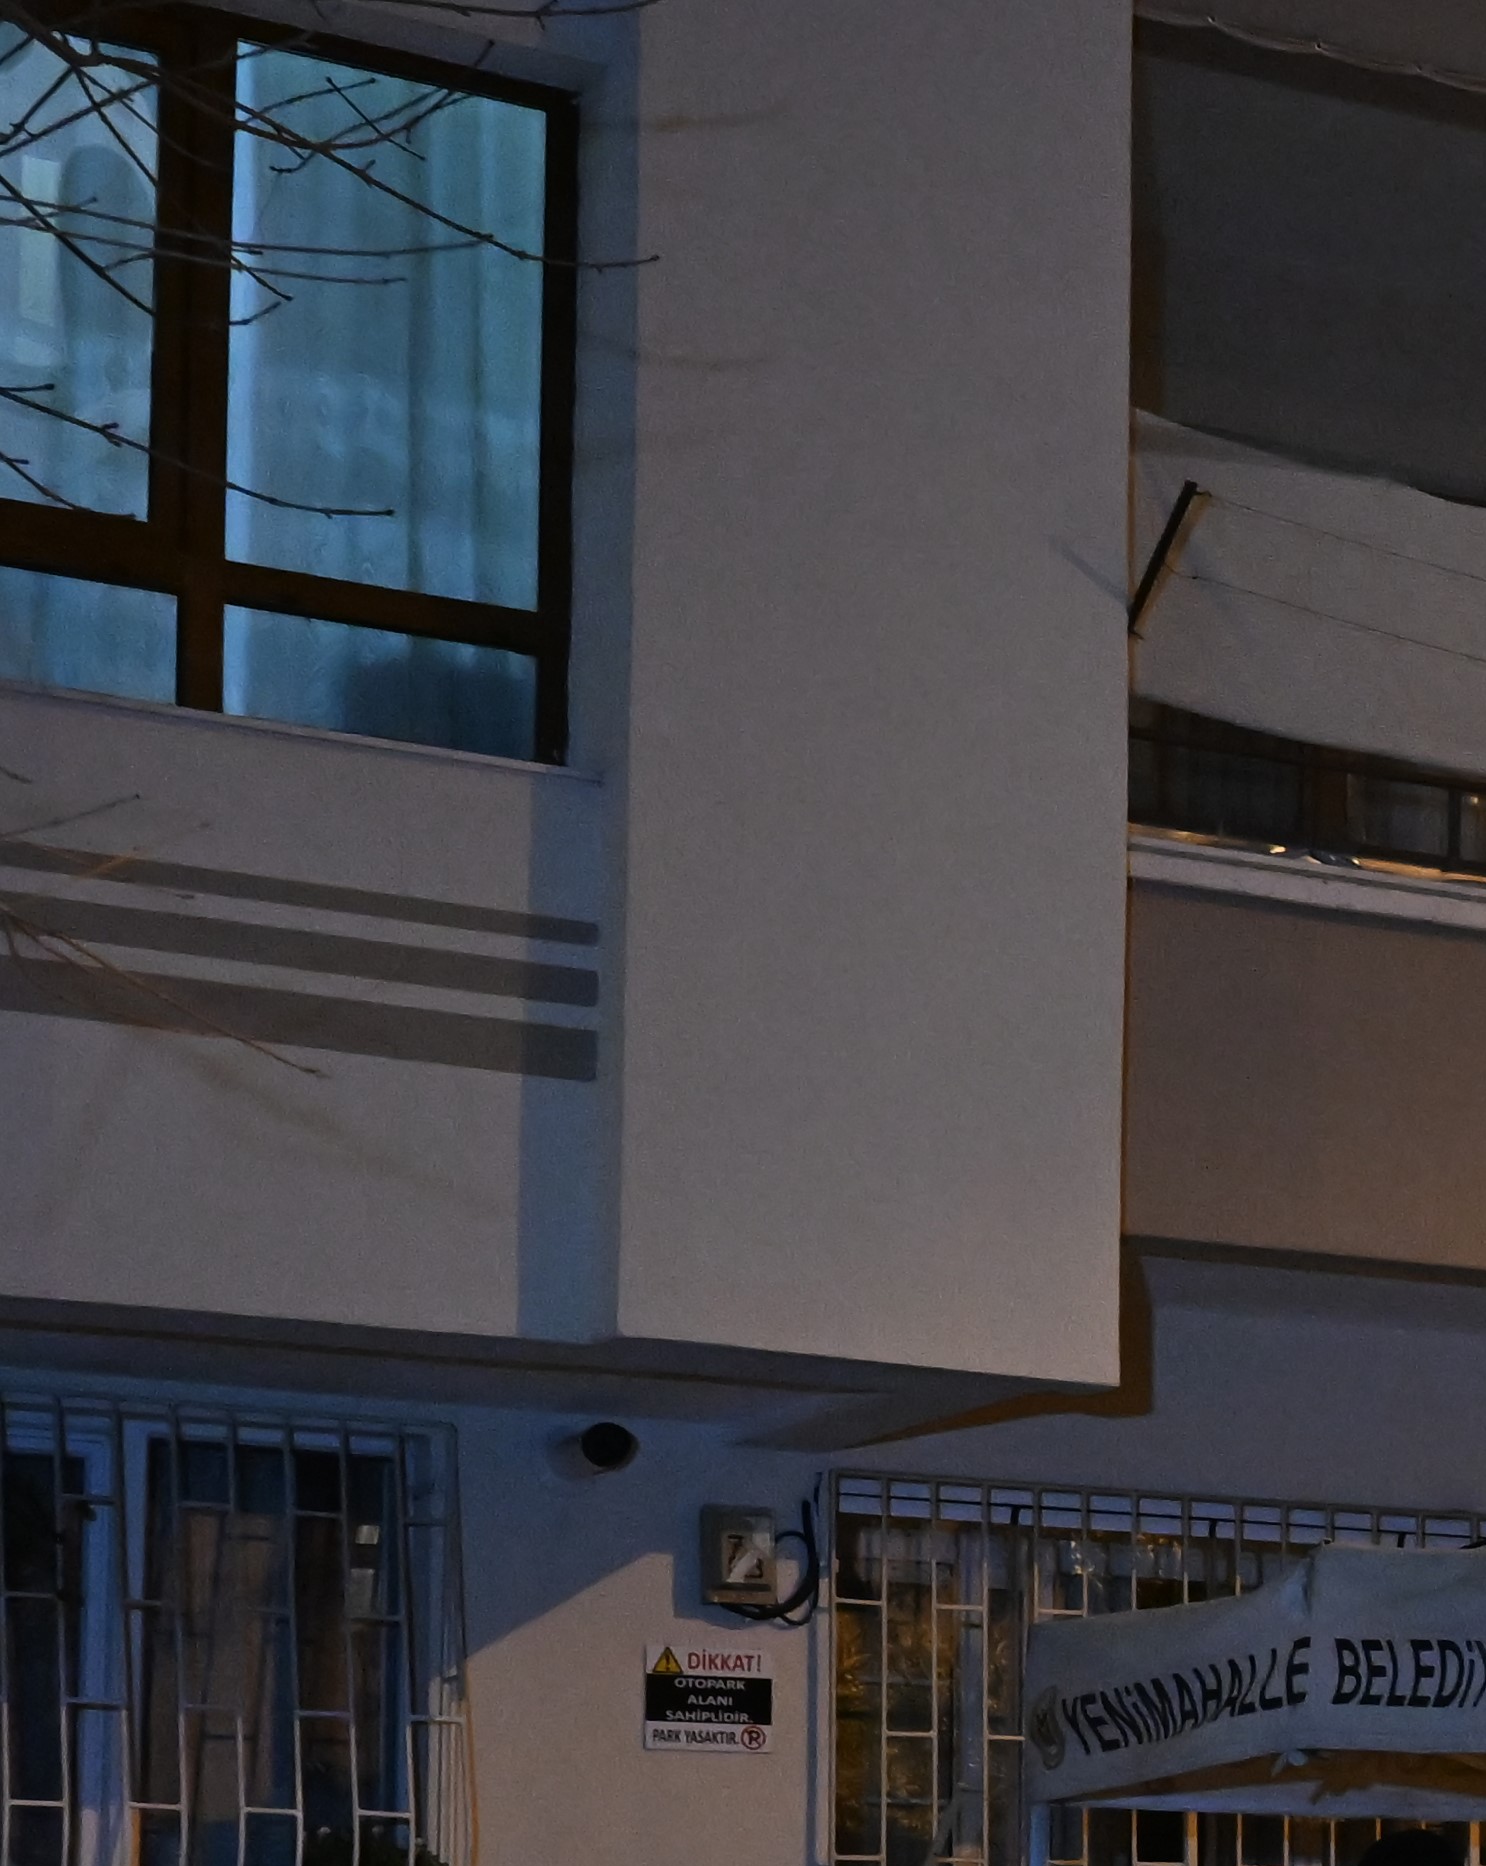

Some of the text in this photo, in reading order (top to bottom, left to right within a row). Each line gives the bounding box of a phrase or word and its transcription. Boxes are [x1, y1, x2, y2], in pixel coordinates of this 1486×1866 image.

[687, 1649, 762, 1673] DİKKAT!
[673, 1676, 746, 1691] OTOPARK
[686, 1694, 733, 1706] ALANI
[652, 1729, 681, 1744] PARK
